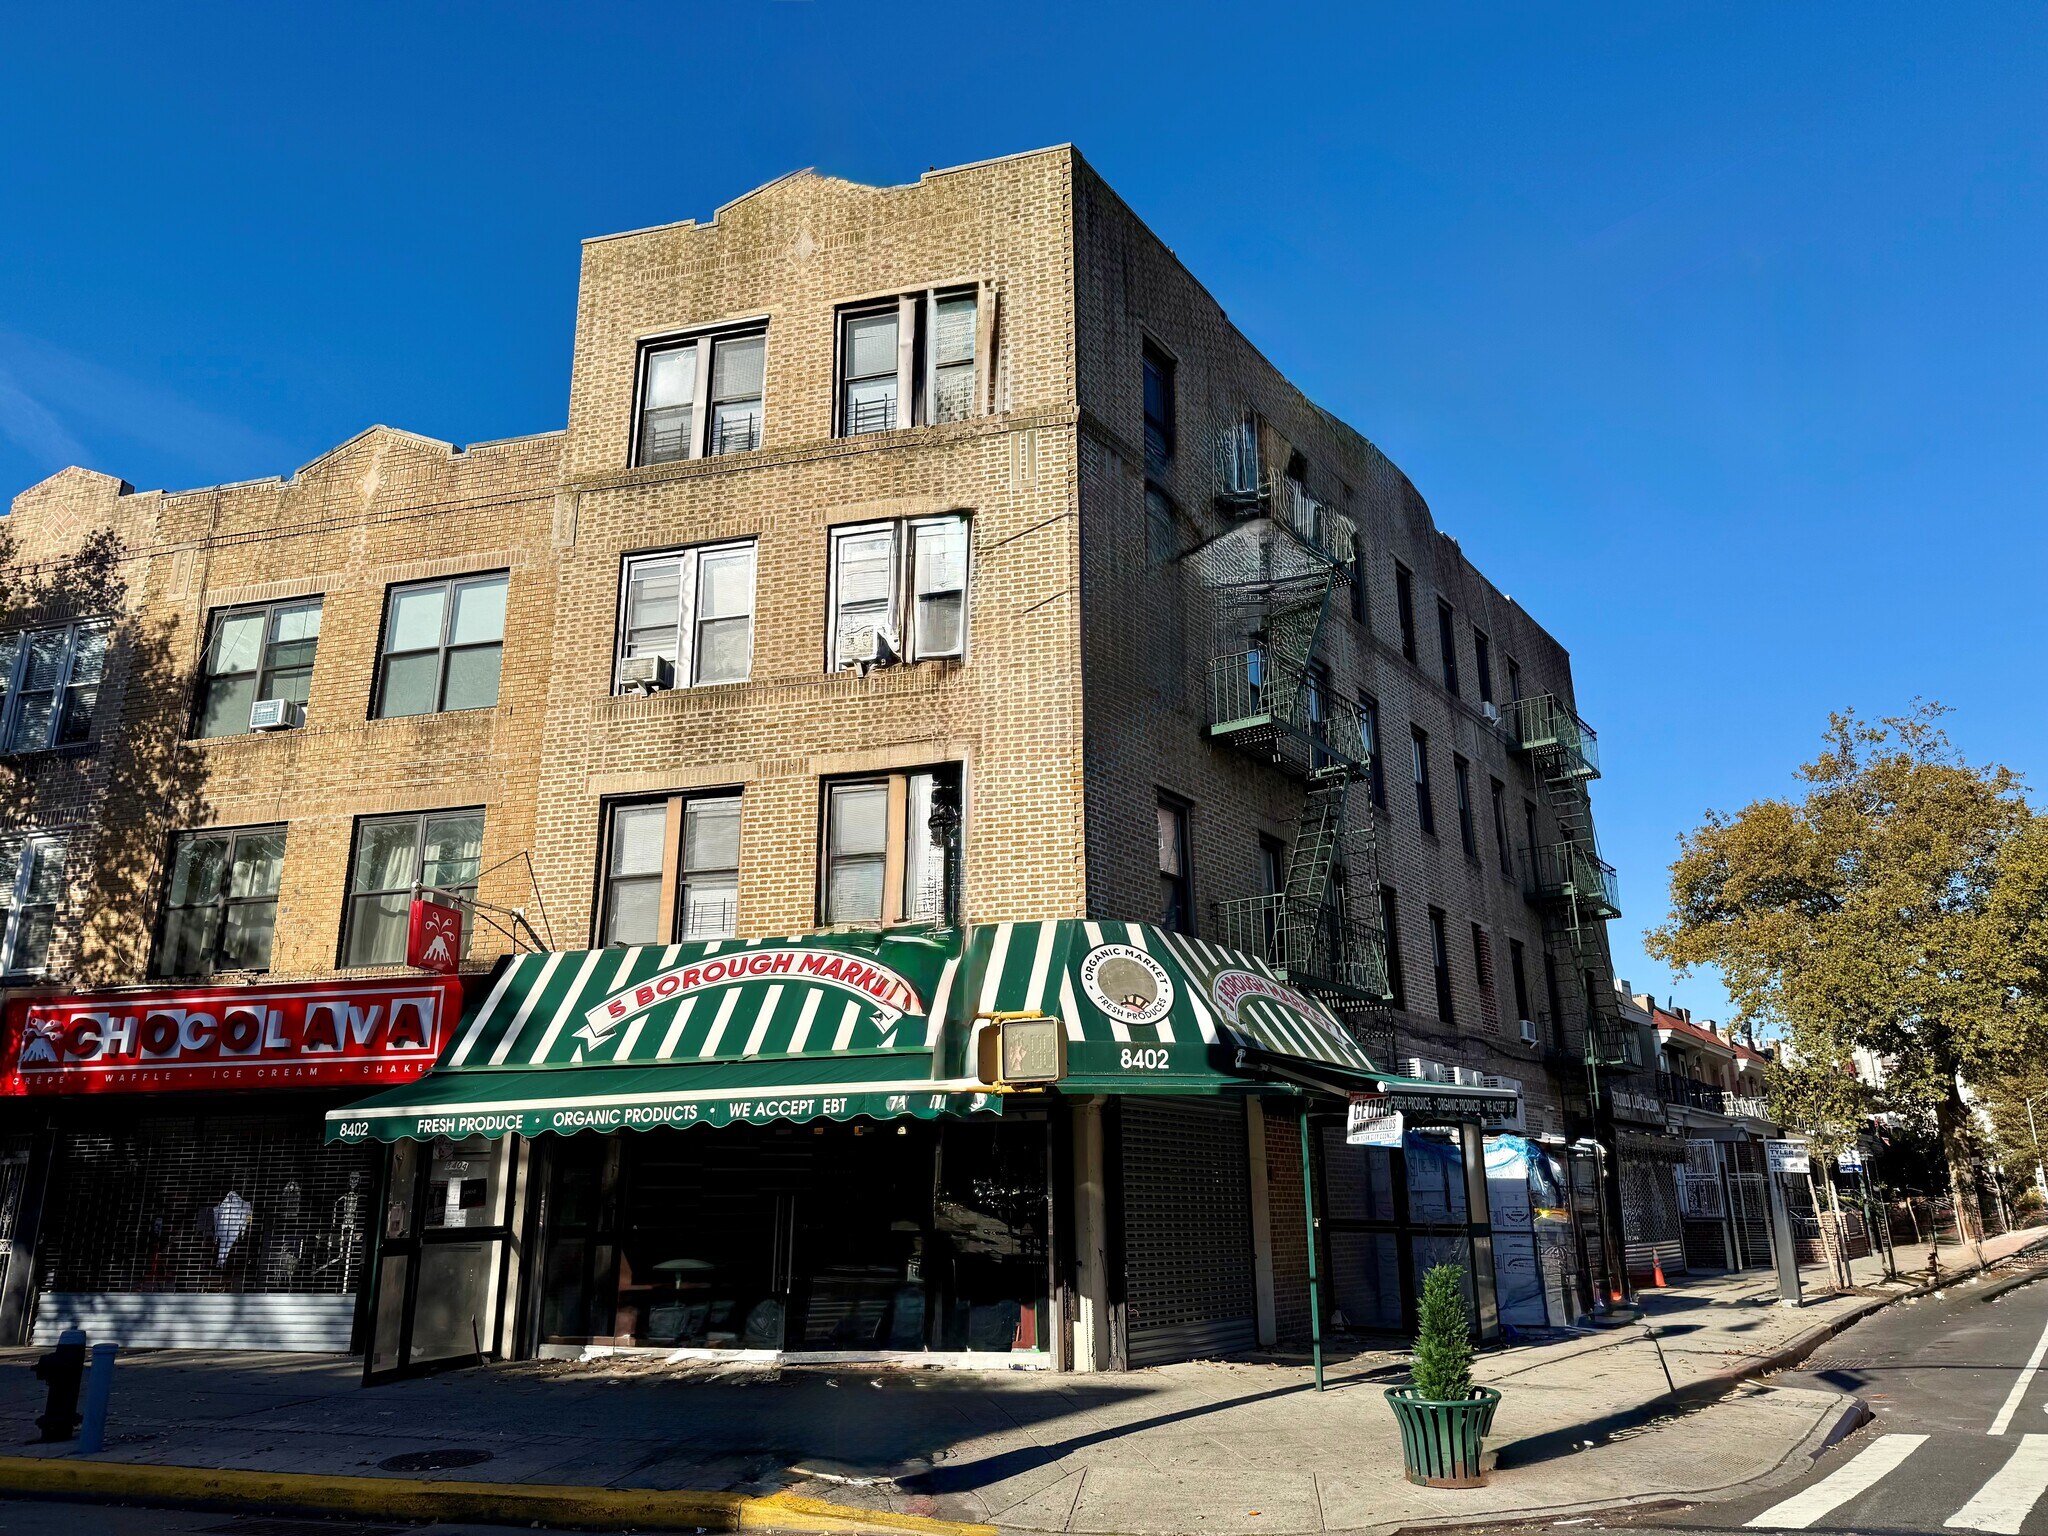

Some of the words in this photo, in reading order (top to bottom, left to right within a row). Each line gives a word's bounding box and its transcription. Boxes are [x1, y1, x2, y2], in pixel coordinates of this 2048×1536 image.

[1085, 948, 1120, 981] ORGANIC
[1125, 949, 1168, 984] MARKET
[608, 1000, 627, 1019] 5
[636, 954, 790, 1007] BOROUGH
[1218, 974, 1270, 1002] BOROUGH
[1266, 982, 1332, 1031] MARKET
[1098, 995, 1123, 1016] FRESH
[1126, 997, 1166, 1020] PRODUCES
[64, 1003, 432, 1058] CHOCOLAVA
[105, 1072, 171, 1082] WAFFLE
[212, 1069, 242, 1079] ICE
[258, 1067, 318, 1077] CREAM
[1120, 1048, 1169, 1069] 8402
[339, 1122, 369, 1137] 8402
[417, 1117, 455, 1134] FRESH
[458, 1115, 523, 1131] PRODUCE
[553, 1109, 621, 1126] ORGANIC
[624, 1104, 698, 1123] PRODUCTS
[729, 1102, 751, 1118] WE
[754, 1099, 815, 1116] ACCEPT
[823, 1097, 847, 1114] EBT
